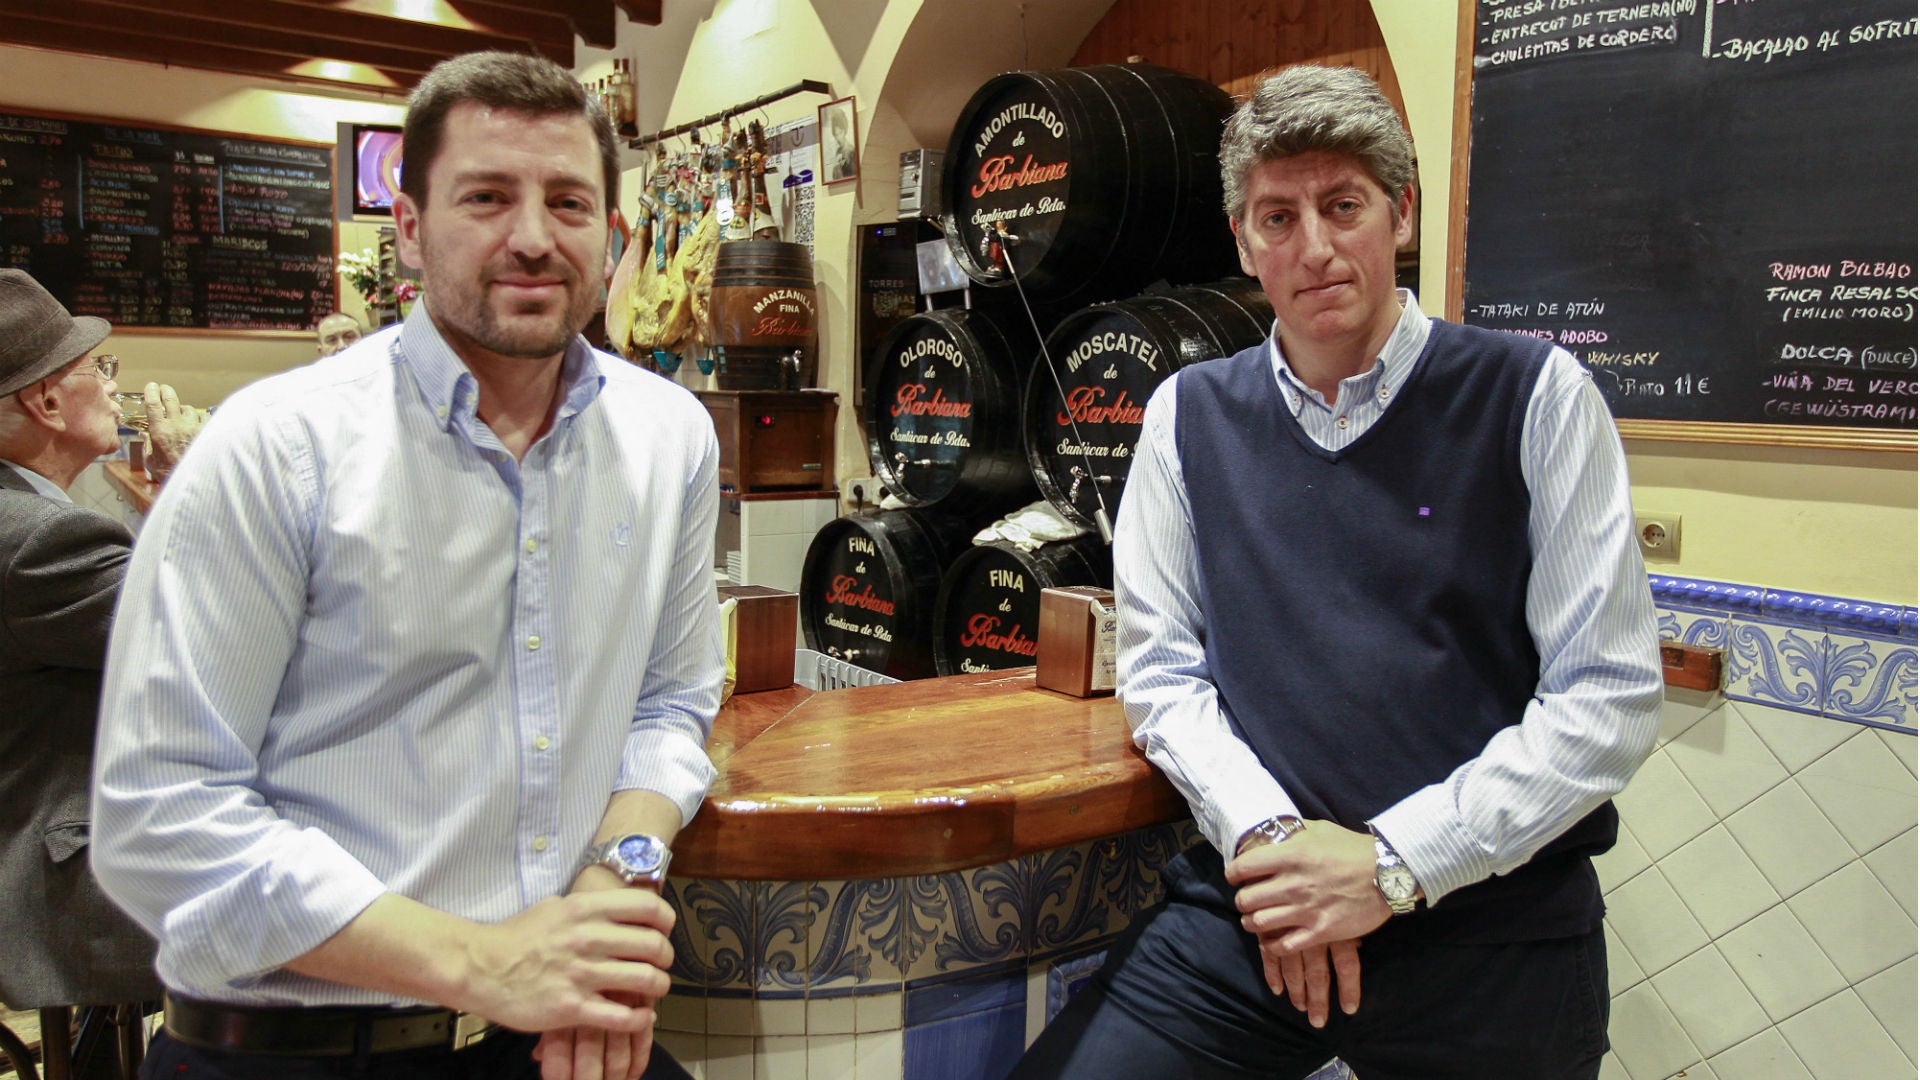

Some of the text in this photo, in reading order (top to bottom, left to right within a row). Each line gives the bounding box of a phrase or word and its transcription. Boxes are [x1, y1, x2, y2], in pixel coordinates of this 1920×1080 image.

[1572, 13, 1592, 28] DE
[1577, 34, 1595, 49] DE
[1817, 29, 1840, 52] AL
[975, 102, 1064, 158] AMONTILLADO
[1012, 131, 1025, 147] de
[970, 153, 1068, 198] Barbiana
[1020, 202, 1035, 217] de
[1036, 196, 1066, 214] Bda.
[1769, 260, 1911, 281] RAMON BILBAO
[1764, 286, 1822, 302] FINCA
[753, 289, 815, 320] MANZANILLA
[779, 304, 800, 313] FINA
[1537, 303, 1559, 317] DE
[1559, 329, 1608, 344] ADOBO
[900, 338, 963, 368] OLOROSO
[1065, 332, 1158, 373] MOSCATEL
[1587, 351, 1660, 366] WHISKY
[924, 365, 936, 378] de
[1103, 363, 1118, 379] de
[1823, 376, 1856, 393] DEL
[890, 383, 972, 418] Barbiana
[1057, 386, 1146, 426] Barbia
[930, 431, 943, 445] de
[944, 430, 971, 448] Bda.
[1111, 442, 1128, 458] de
[848, 537, 875, 557] FINA
[855, 561, 866, 574] de
[989, 569, 1024, 593] FINA
[825, 573, 895, 616] Barbiana
[999, 598, 1012, 612] de
[860, 623, 873, 636] de
[960, 613, 1039, 656] Barbia
